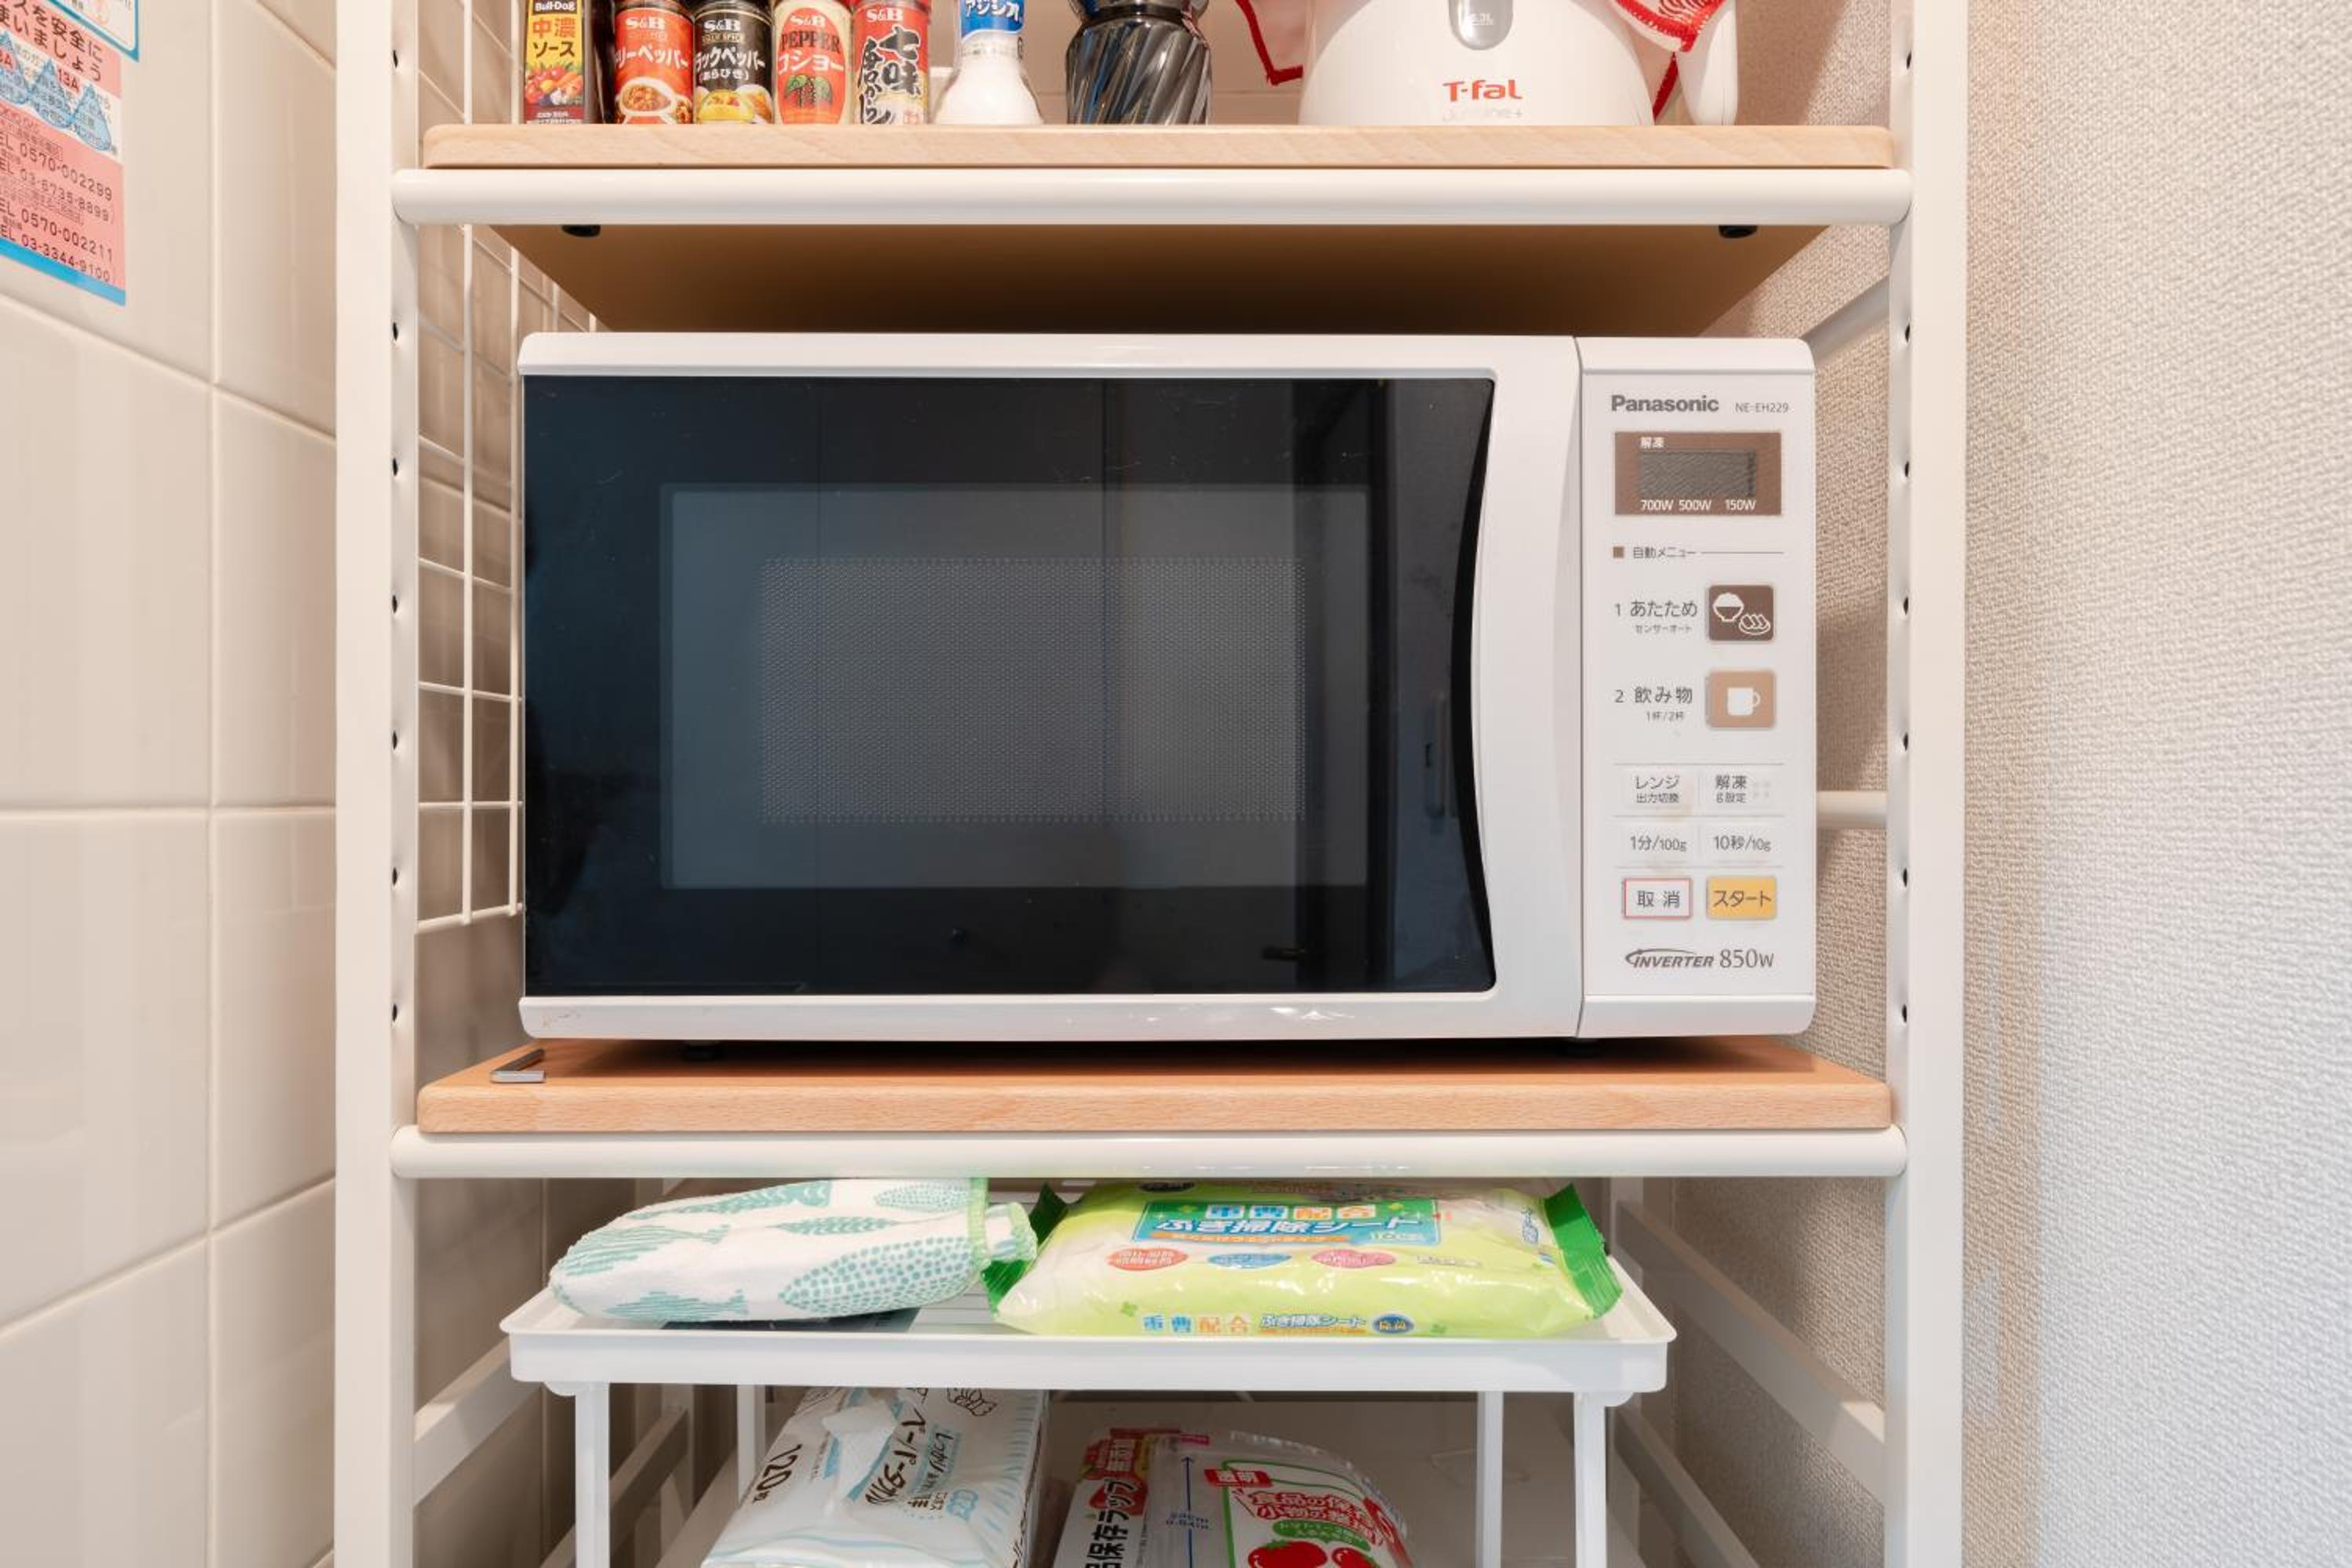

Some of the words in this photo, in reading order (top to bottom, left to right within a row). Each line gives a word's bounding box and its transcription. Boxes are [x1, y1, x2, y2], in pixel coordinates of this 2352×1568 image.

[625, 16, 666, 30] S&B
[790, 16, 826, 28] S&B
[866, 7, 903, 22] S&B
[533, 17, 576, 38] 中濃
[703, 18, 741, 31] S&B
[533, 42, 575, 58] ソース
[780, 31, 841, 53] PEPPER
[1442, 79, 1523, 102] T-fal
[1611, 394, 1719, 412] Panasonic
[1735, 402, 1789, 412] NE-EH229
[1641, 499, 1674, 510] 700W
[1679, 499, 1711, 510] 500W
[1725, 499, 1756, 510] 150W
[1633, 546, 1697, 558] 自動メニュー
[1615, 603, 1621, 616] 1
[1630, 600, 1697, 618] あたため
[1614, 689, 1624, 703] 2
[1634, 686, 1693, 704] 飲み物
[1635, 775, 1680, 789] レンジ
[1715, 774, 1747, 789] 解凍
[1630, 834, 1686, 852] 1分/100g
[1714, 833, 1771, 852] 10秒/10g
[1713, 890, 1773, 908] スタート
[1627, 950, 1715, 968] INVERTER
